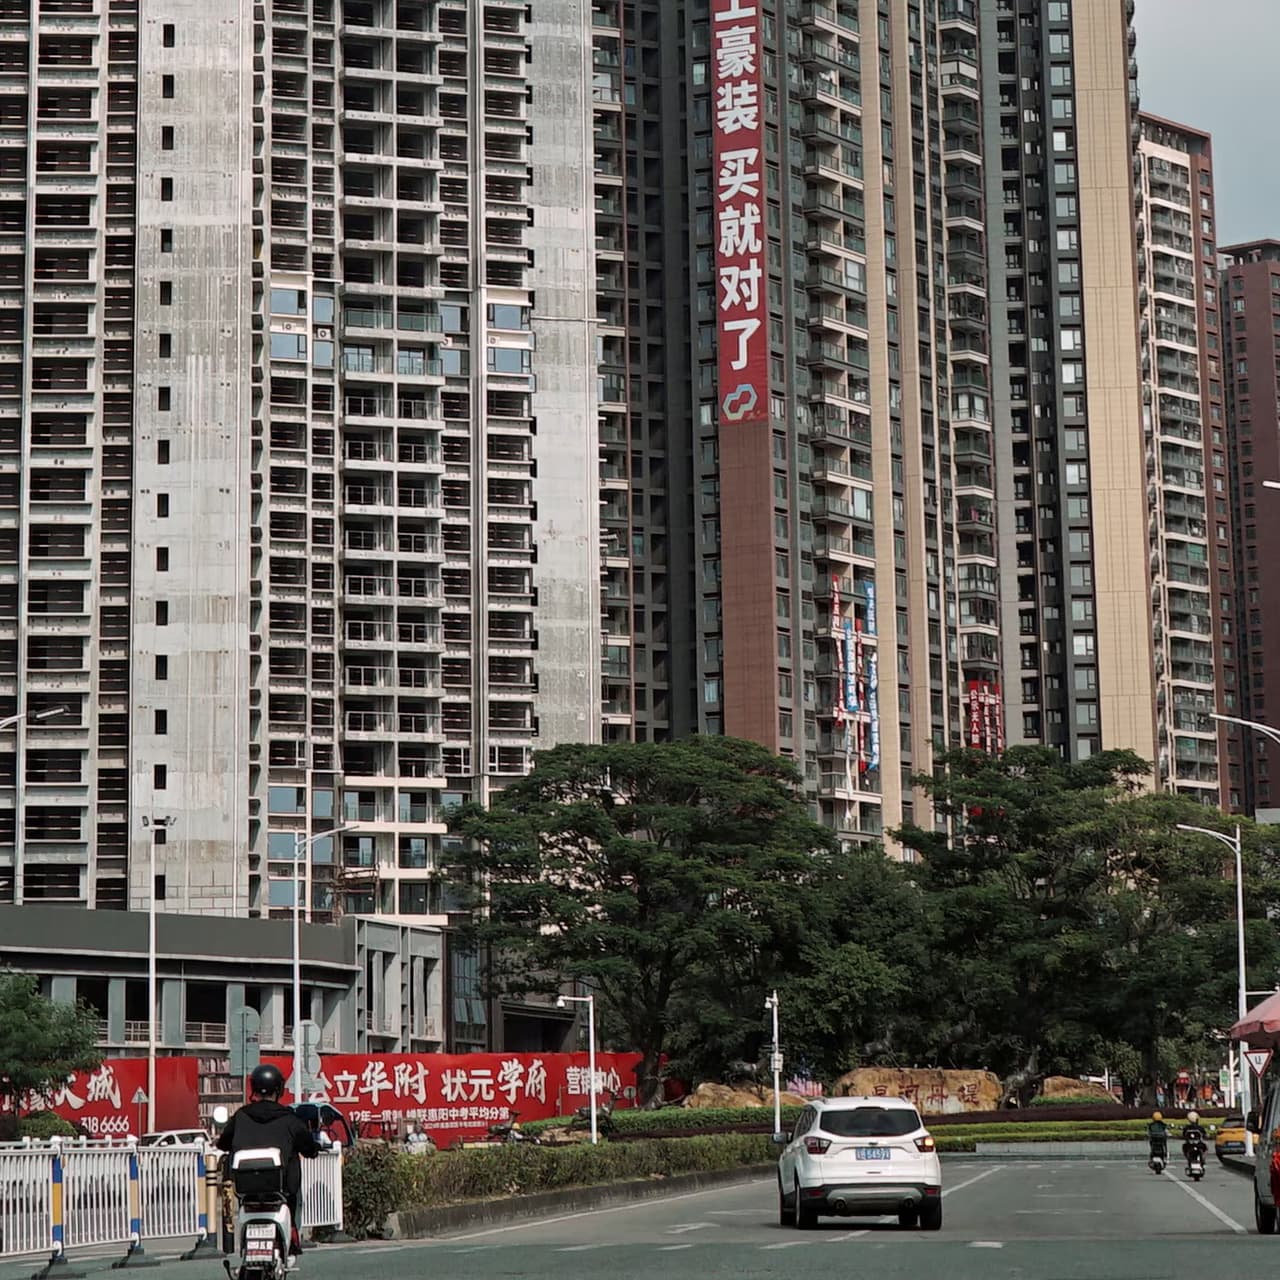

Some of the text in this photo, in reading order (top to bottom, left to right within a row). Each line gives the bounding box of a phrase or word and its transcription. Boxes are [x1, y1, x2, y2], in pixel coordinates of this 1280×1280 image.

[718, 147, 762, 370] 买就对了
[441, 1058, 547, 1105] 状元学府
